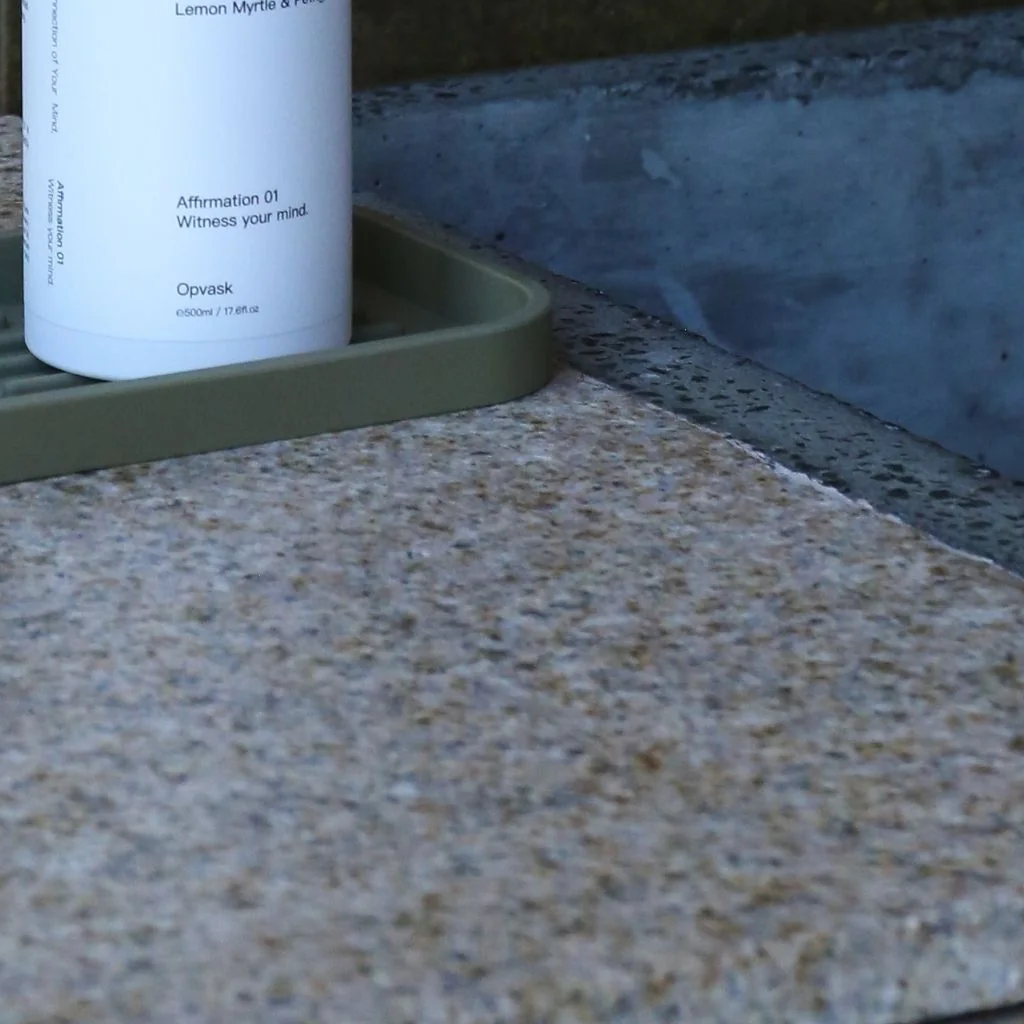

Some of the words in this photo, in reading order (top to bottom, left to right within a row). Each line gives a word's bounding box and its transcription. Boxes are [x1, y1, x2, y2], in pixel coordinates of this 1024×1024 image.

[175, 3, 227, 16] Lemon
[51, 51, 59, 65] of
[51, 68, 59, 96] Your
[47, 178, 55, 224] Witness
[176, 194, 259, 209] Affirmation
[264, 189, 278, 204] 01
[56, 180, 65, 248] Affirmation
[176, 215, 237, 228] Witness
[242, 212, 272, 228] your
[277, 203, 308, 221] mind.
[56, 251, 64, 266] 01
[176, 282, 233, 299] Opvask
[216, 306, 222, 317] /
